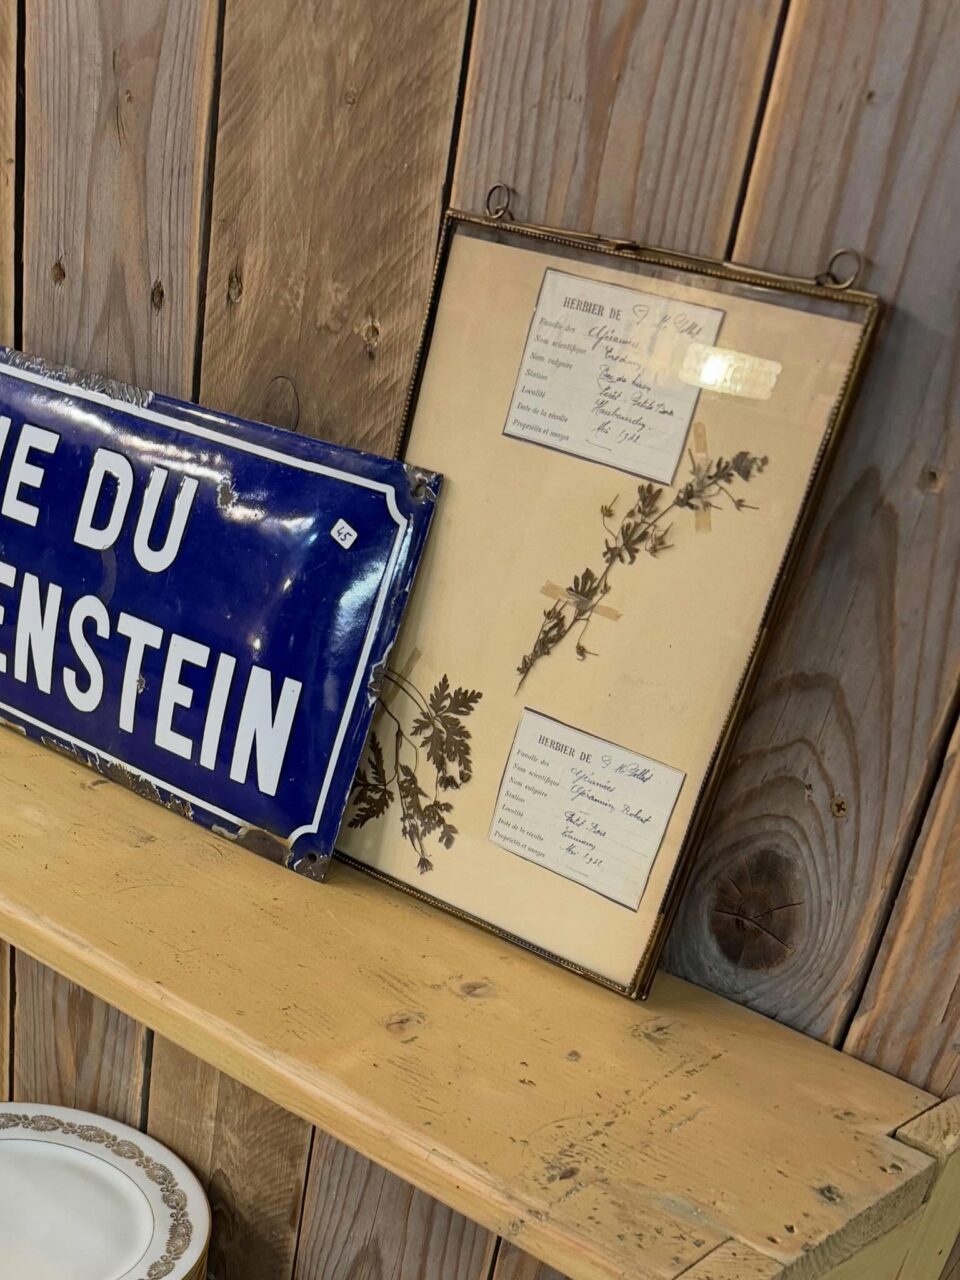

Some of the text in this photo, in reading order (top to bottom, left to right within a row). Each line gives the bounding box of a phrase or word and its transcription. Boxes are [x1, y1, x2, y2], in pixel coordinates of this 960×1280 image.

[563, 297, 604, 316] HERBIER
[608, 307, 623, 321] DE
[521, 386, 546, 398] Localité
[516, 401, 531, 411] Date
[74, 448, 199, 573] DU
[516, 749, 539, 763] Famille
[538, 735, 575, 757] HERBIER
[578, 751, 592, 764] DE
[529, 770, 560, 787] scientifique
[504, 789, 525, 804] Station
[501, 803, 523, 818] Localité
[497, 816, 511, 827] Date
